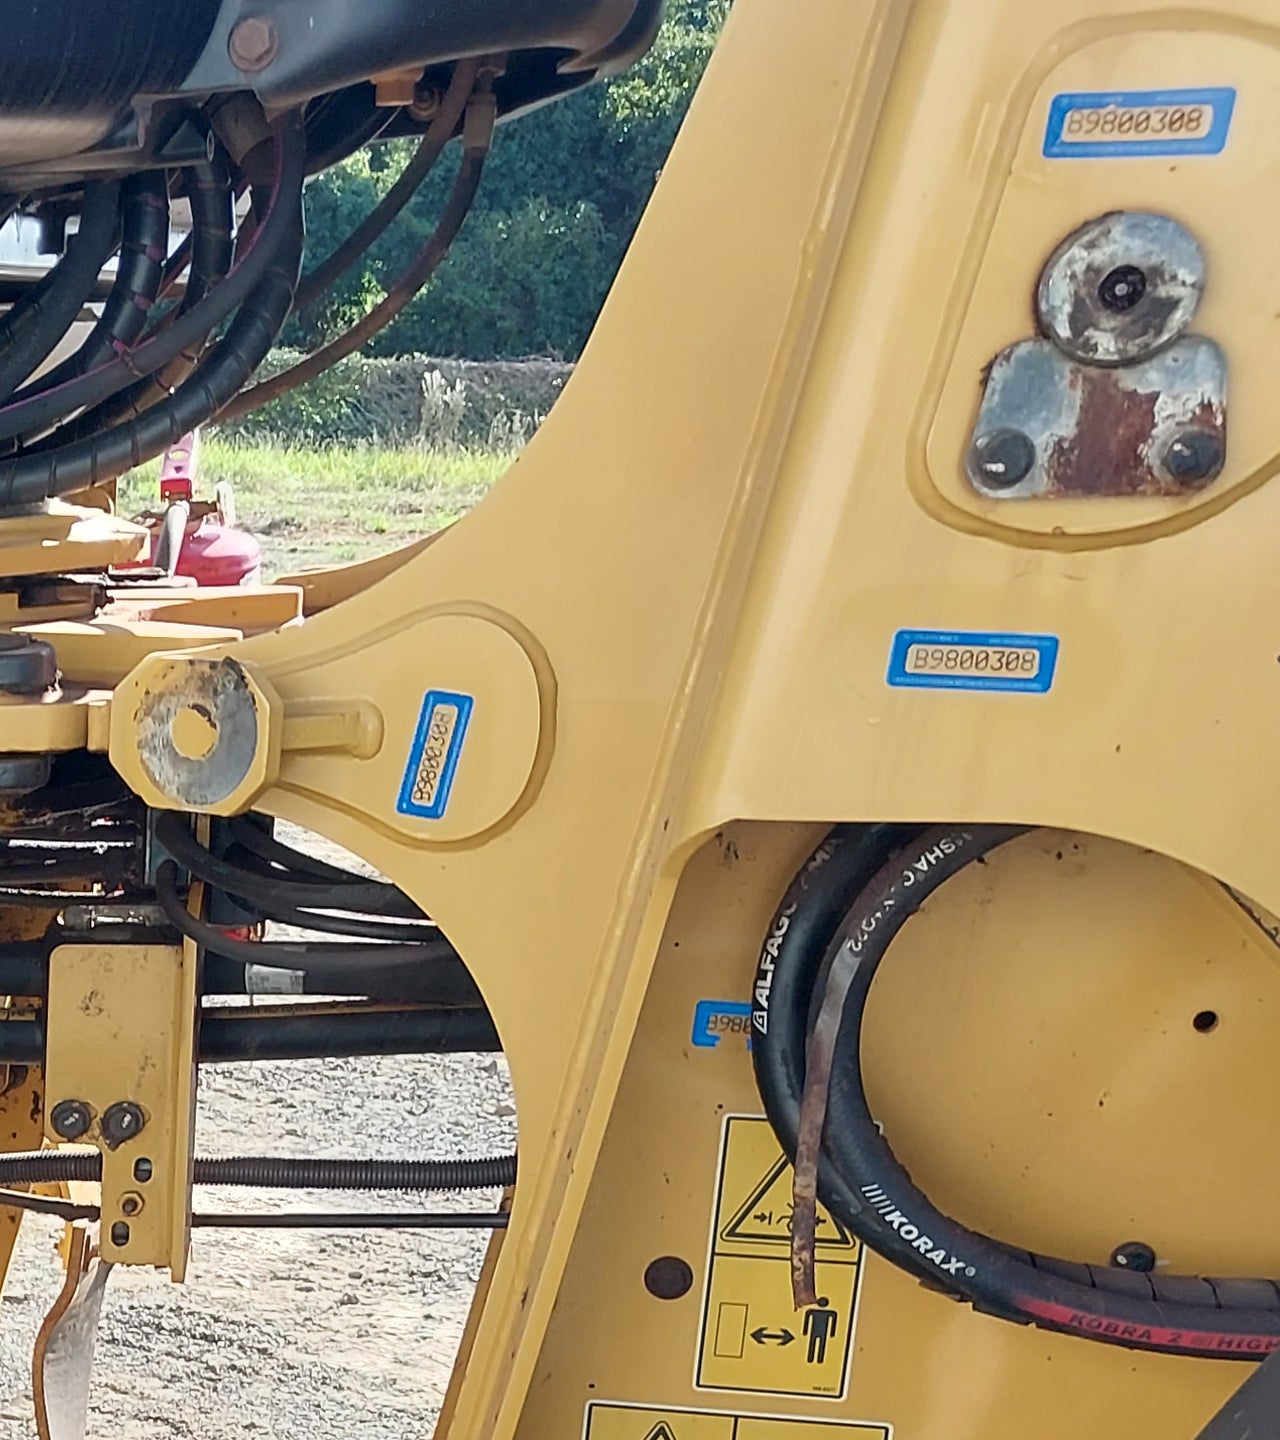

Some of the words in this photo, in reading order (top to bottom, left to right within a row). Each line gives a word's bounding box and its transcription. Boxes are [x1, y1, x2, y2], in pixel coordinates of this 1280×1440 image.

[913, 647, 1036, 672] B9800308
[1069, 1314, 1151, 1341] KOBRA
[1168, 1331, 1182, 1343] 2
